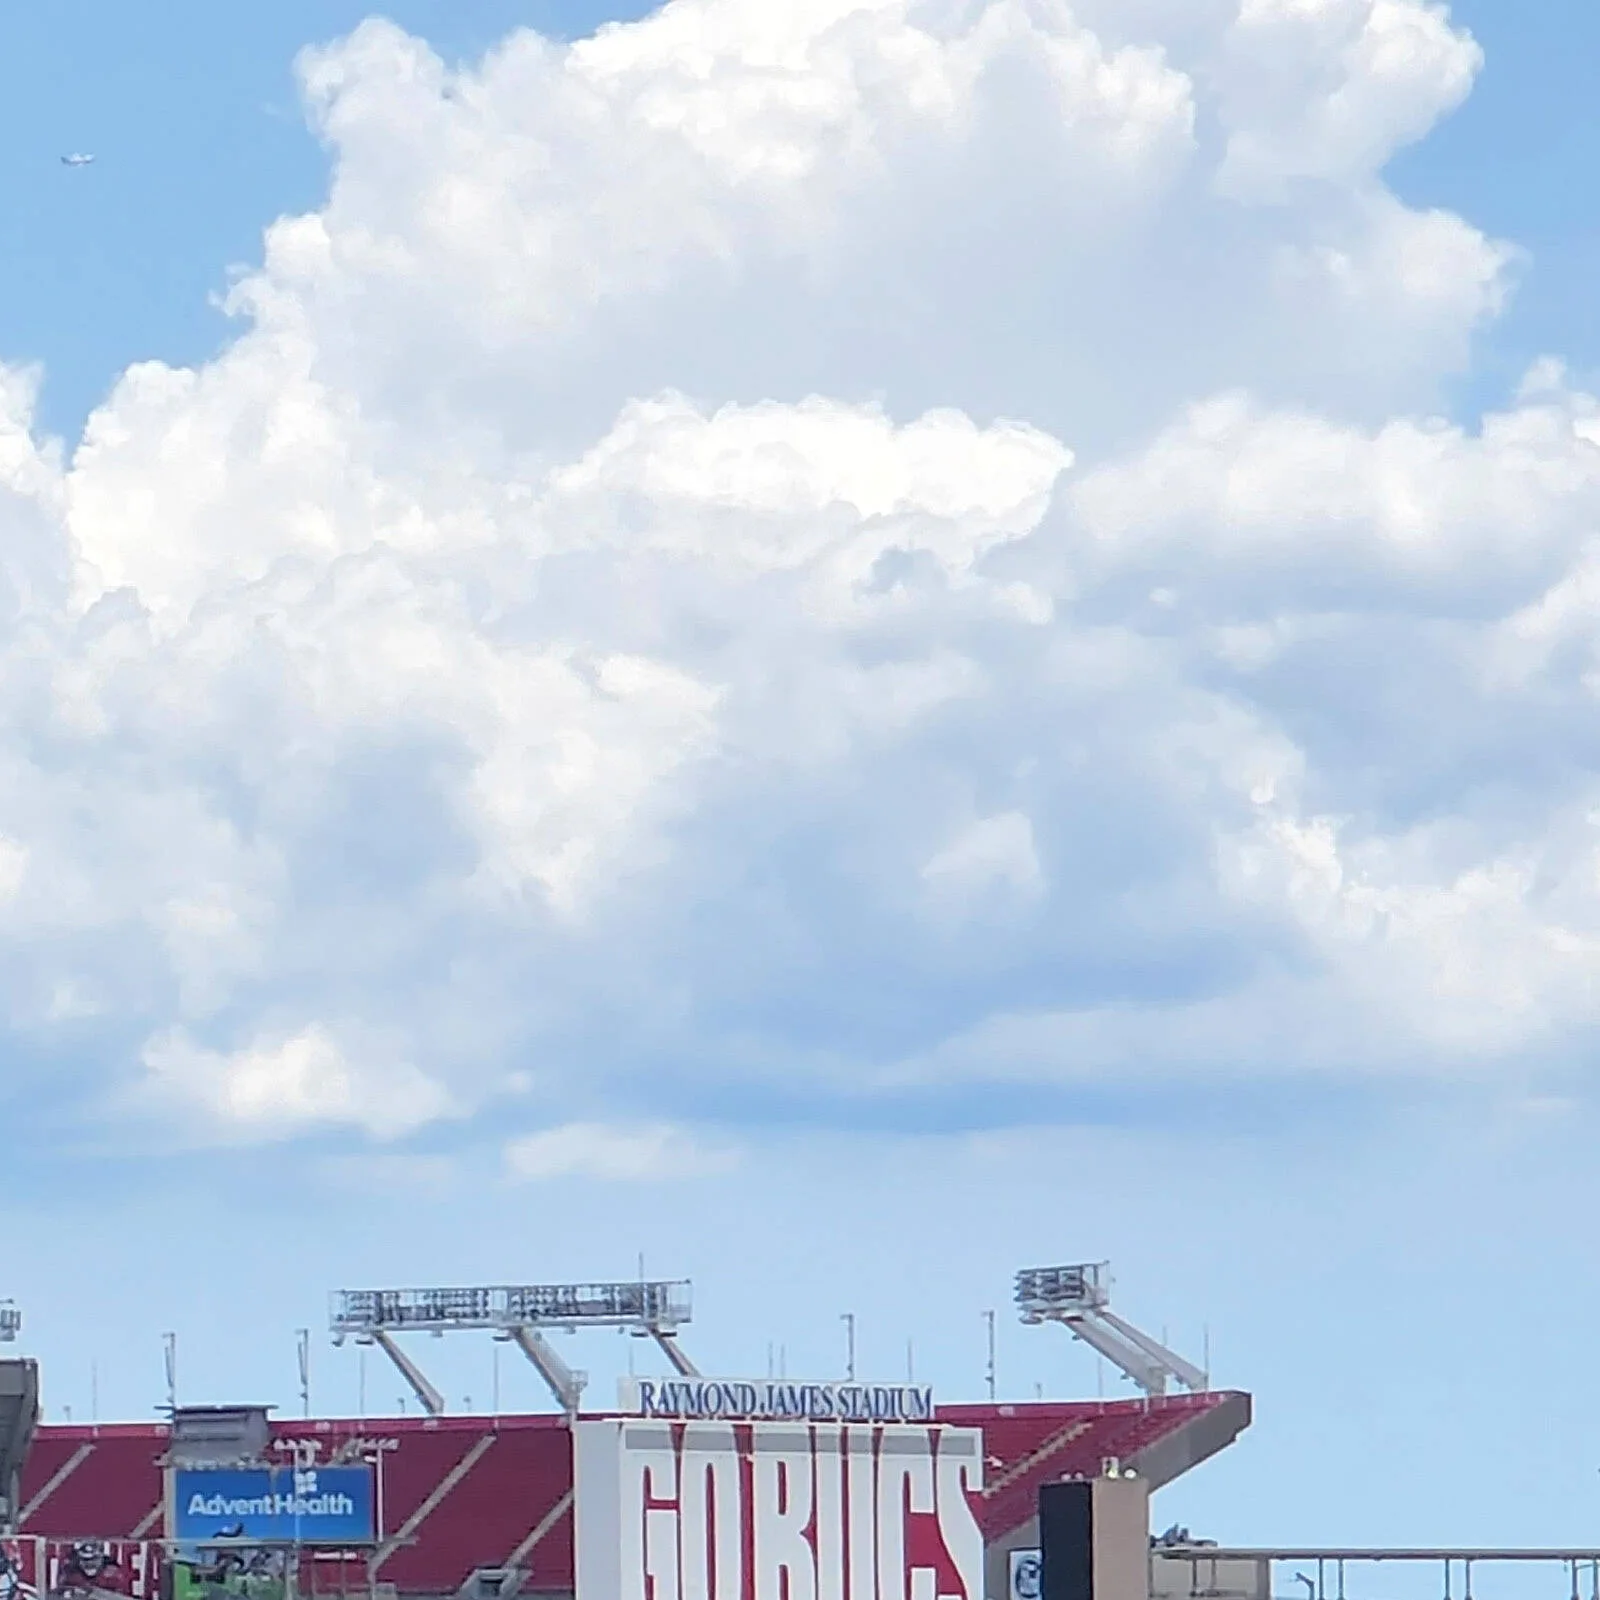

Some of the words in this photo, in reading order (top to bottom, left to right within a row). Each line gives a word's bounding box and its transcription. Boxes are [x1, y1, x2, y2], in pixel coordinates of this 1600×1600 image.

[638, 1381, 756, 1416] RAYMOND
[760, 1384, 833, 1417] JAMES
[837, 1385, 934, 1419] STADIUM
[187, 1491, 354, 1516] AdventHealth
